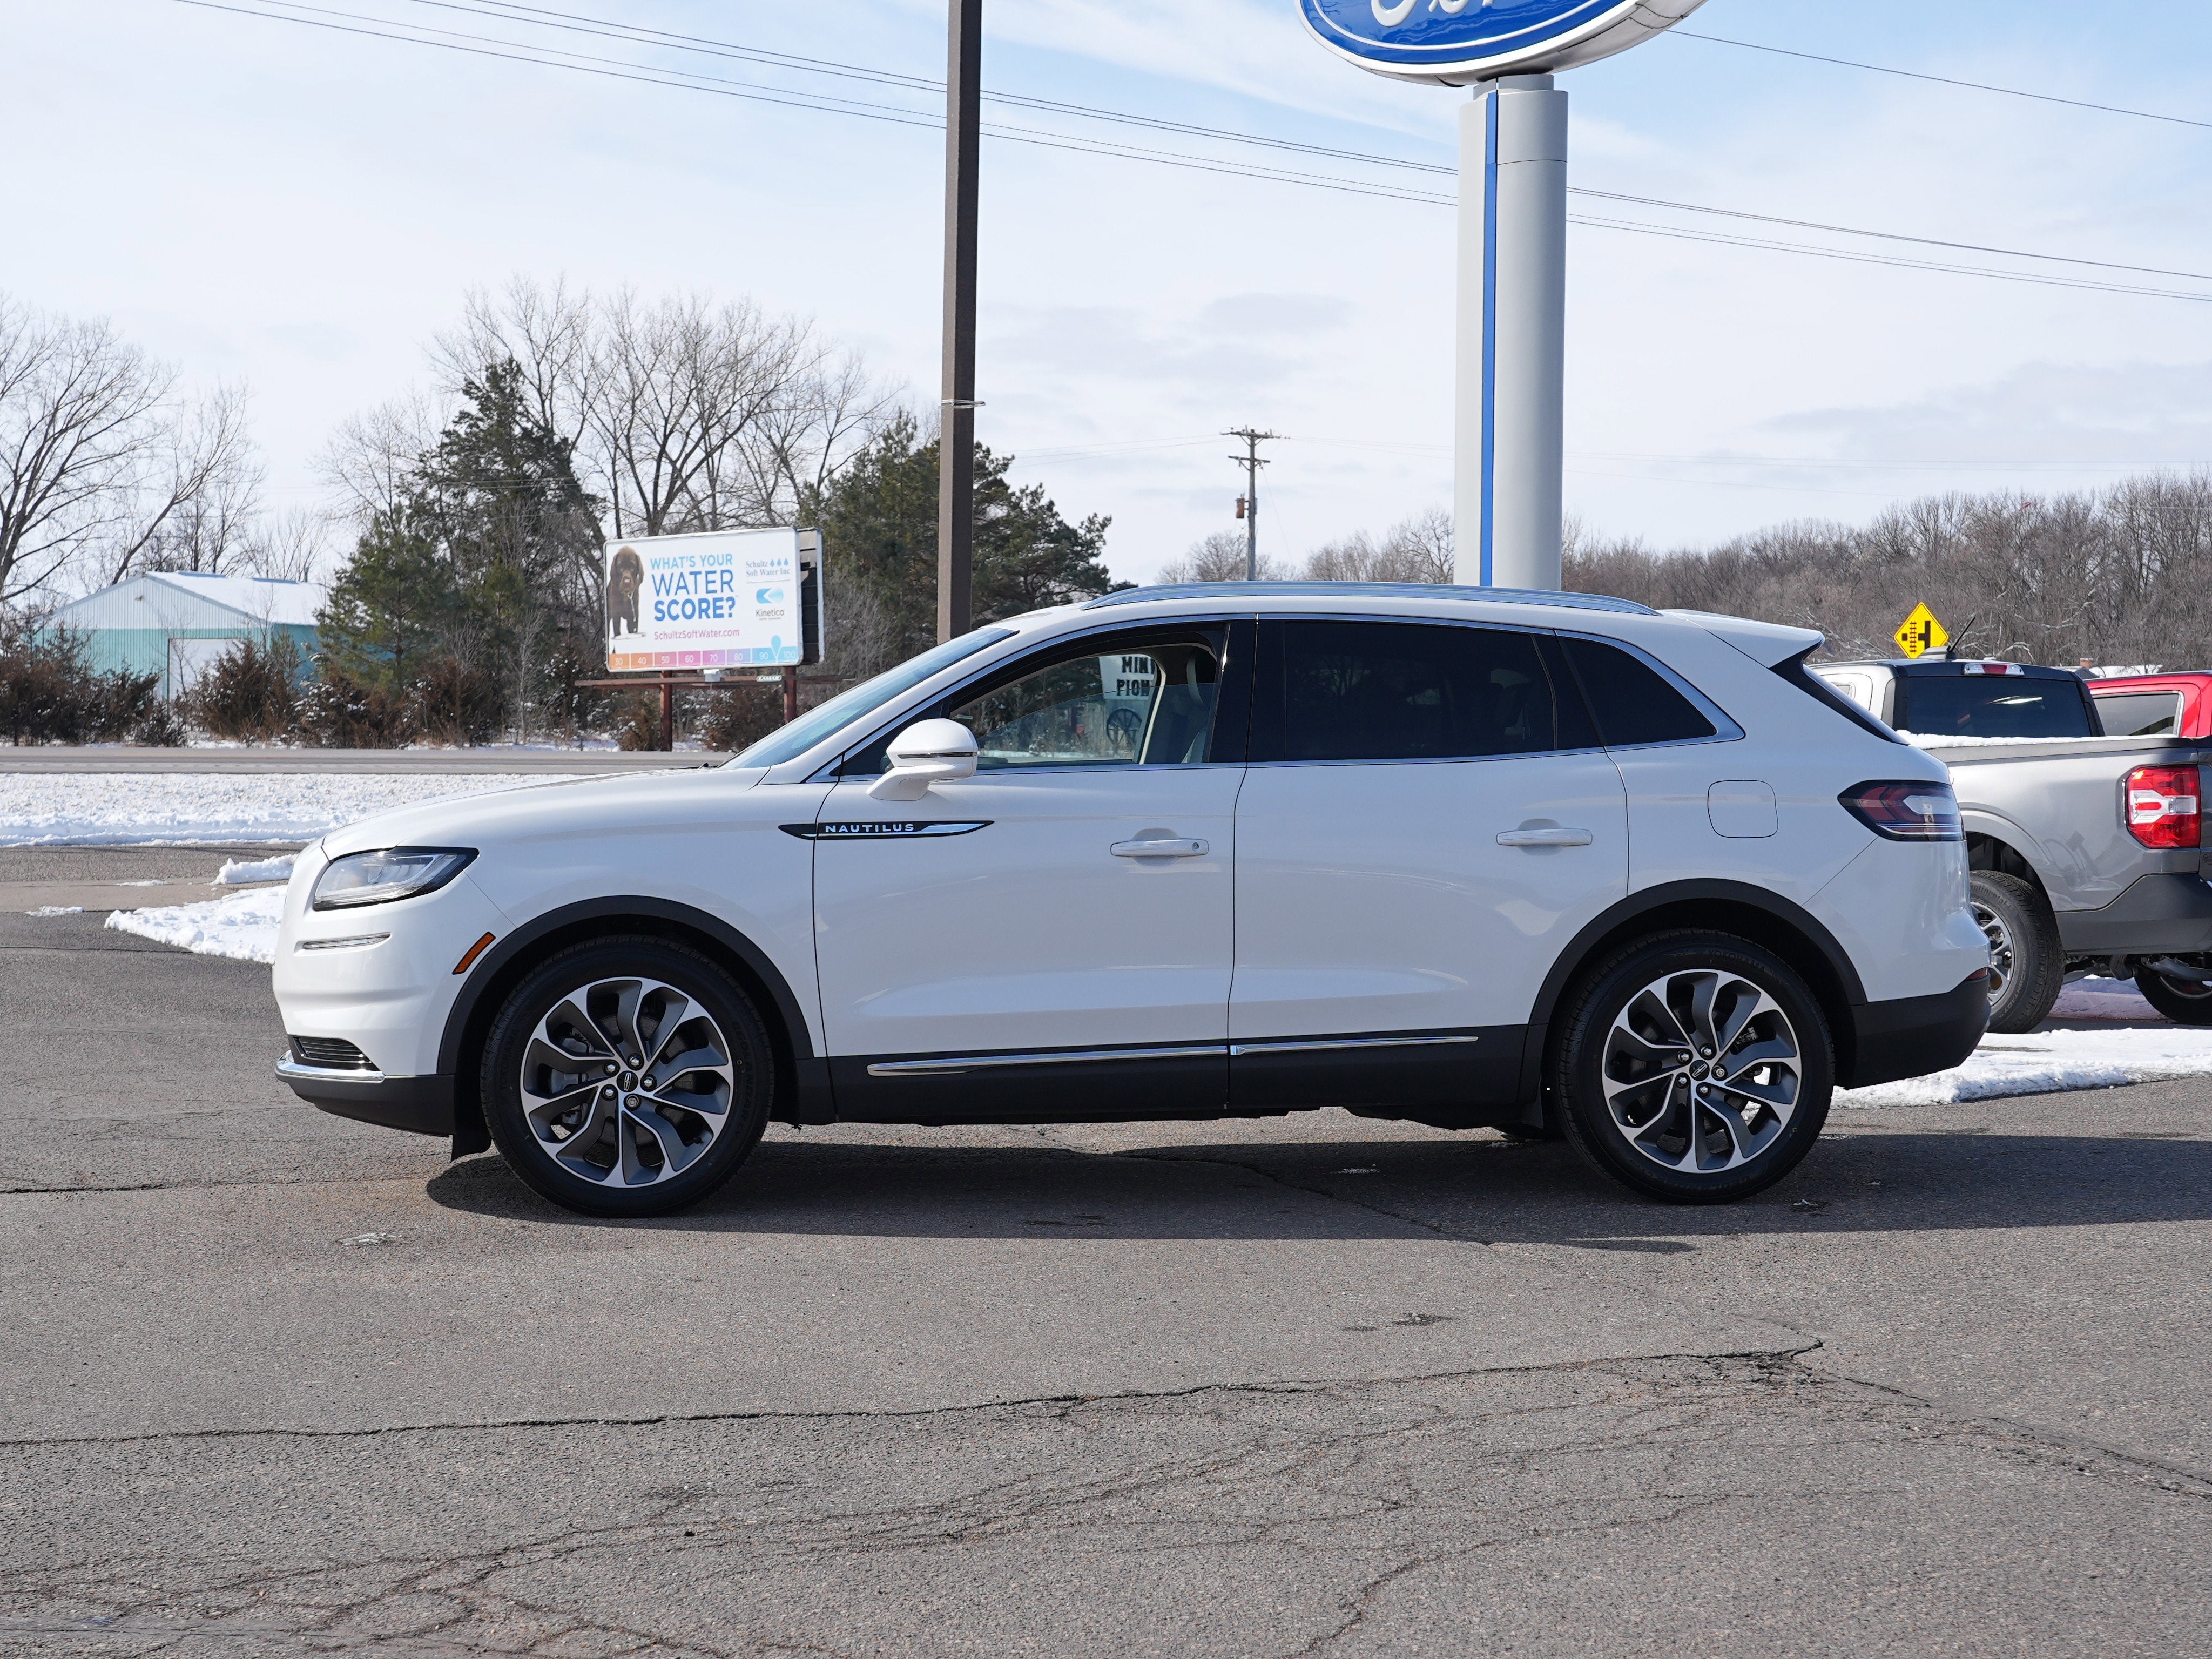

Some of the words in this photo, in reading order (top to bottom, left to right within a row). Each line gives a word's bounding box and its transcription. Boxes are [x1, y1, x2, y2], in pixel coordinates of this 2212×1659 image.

[650, 555, 696, 569] WHAT'S
[700, 554, 733, 567] YOUR
[651, 569, 733, 596] WATER
[654, 596, 736, 621] SCORE?
[756, 608, 784, 617] Kinetico
[655, 629, 739, 640] SchultzSoftWater.com
[685, 655, 694, 663] 60
[709, 653, 718, 662] 70
[734, 653, 743, 661] 80
[759, 652, 768, 660] 90
[784, 650, 795, 659] 100
[615, 657, 623, 666] 30
[661, 656, 670, 664] 50
[825, 824, 914, 833] NAUTILUS
[498, 1029, 520, 1091] YOKOHAMA
